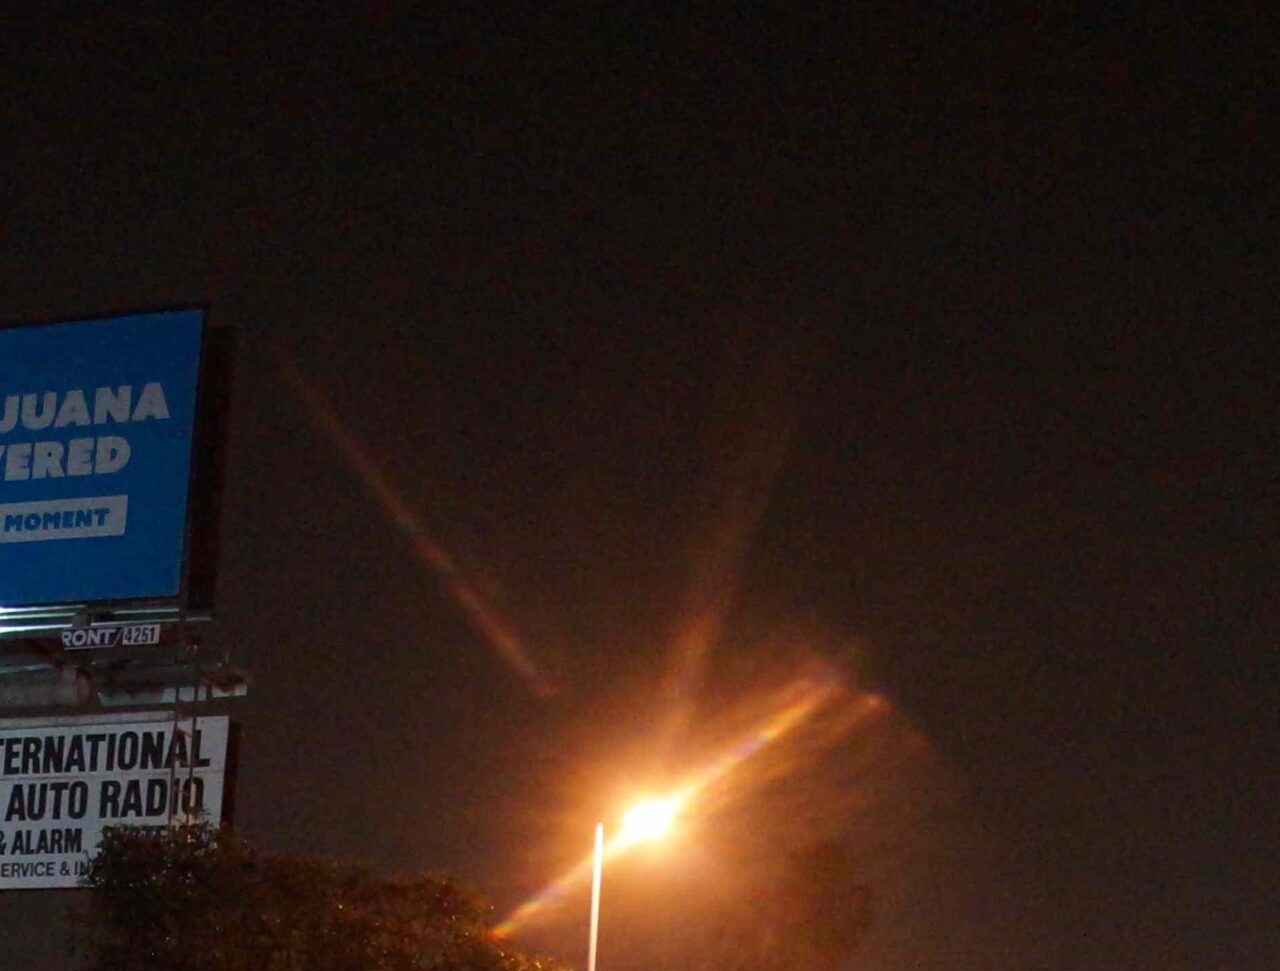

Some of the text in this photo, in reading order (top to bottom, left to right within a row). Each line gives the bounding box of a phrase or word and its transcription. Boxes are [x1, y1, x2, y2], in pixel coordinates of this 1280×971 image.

[4, 507, 110, 533] MOMENT
[125, 626, 155, 643] 4251
[5, 775, 204, 822] AUTO RADIO
[10, 828, 83, 855] ALARM
[60, 861, 70, 876] &
